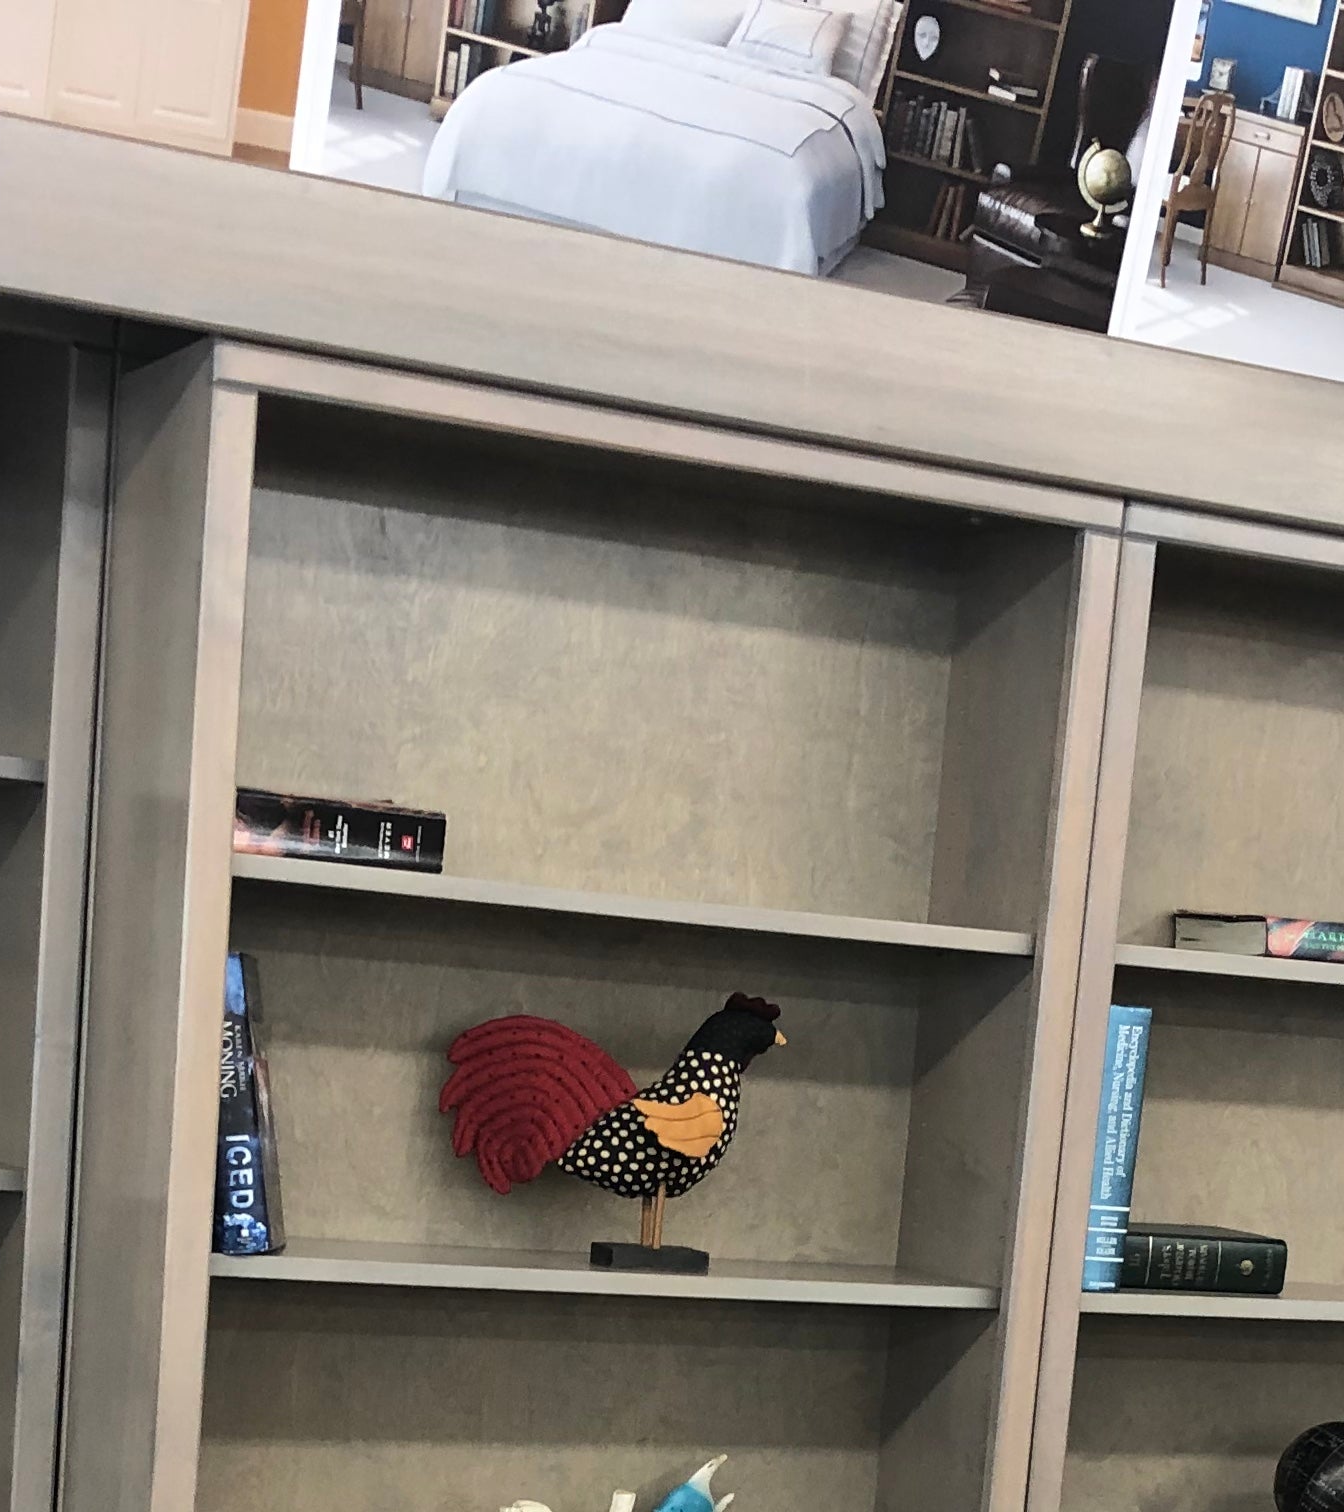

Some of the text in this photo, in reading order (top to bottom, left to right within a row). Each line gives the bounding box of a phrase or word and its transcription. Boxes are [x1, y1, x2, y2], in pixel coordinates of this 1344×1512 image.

[383, 822, 393, 859] MEYER
[220, 1020, 238, 1099] MONING
[1112, 1024, 1131, 1071] Medicine,
[1116, 1025, 1143, 1178] Encyclopedia and Dictionary of
[1106, 1115, 1119, 1134] and
[1103, 1136, 1119, 1165] Allied
[225, 1134, 255, 1210] ICED
[1100, 1166, 1115, 1200] Health
